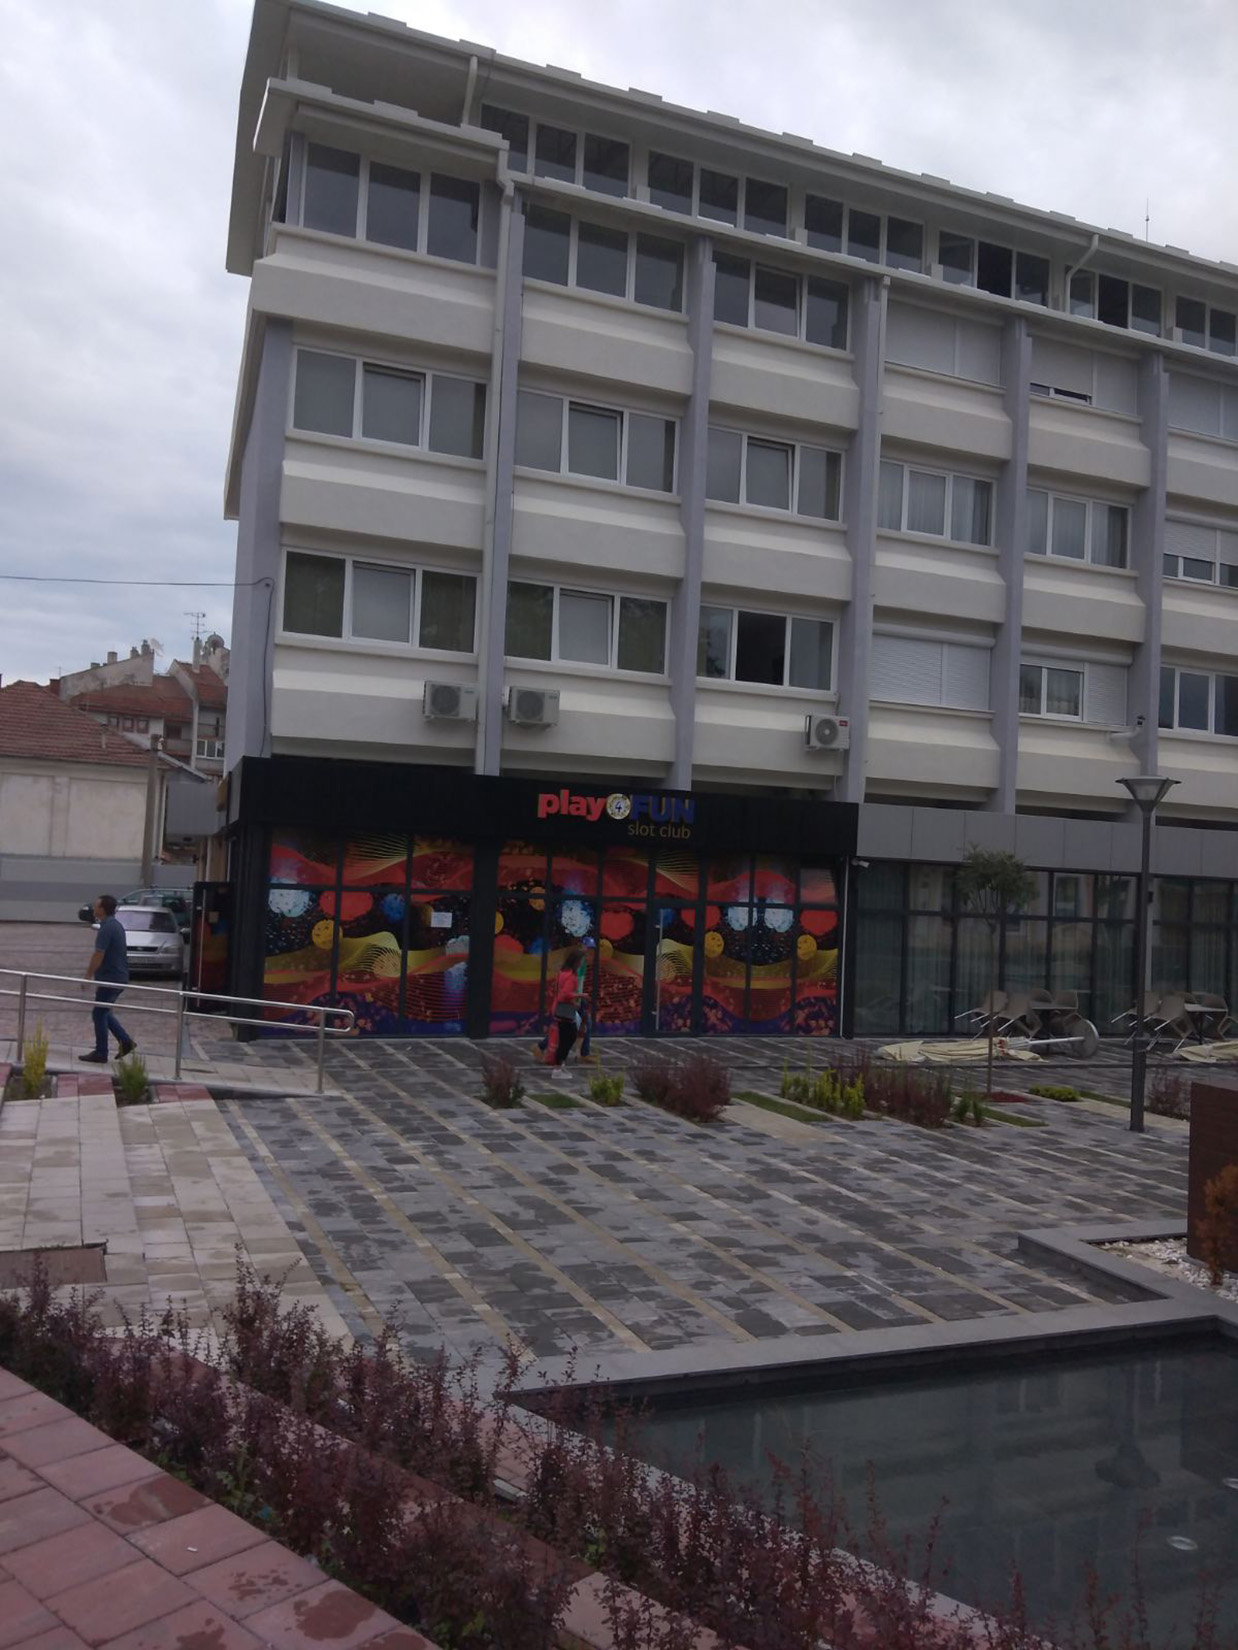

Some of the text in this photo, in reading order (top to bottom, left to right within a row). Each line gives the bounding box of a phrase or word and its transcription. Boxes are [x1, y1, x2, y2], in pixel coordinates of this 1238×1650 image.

[537, 789, 606, 821] play
[630, 794, 695, 824] FUN
[628, 822, 691, 839] slot club
